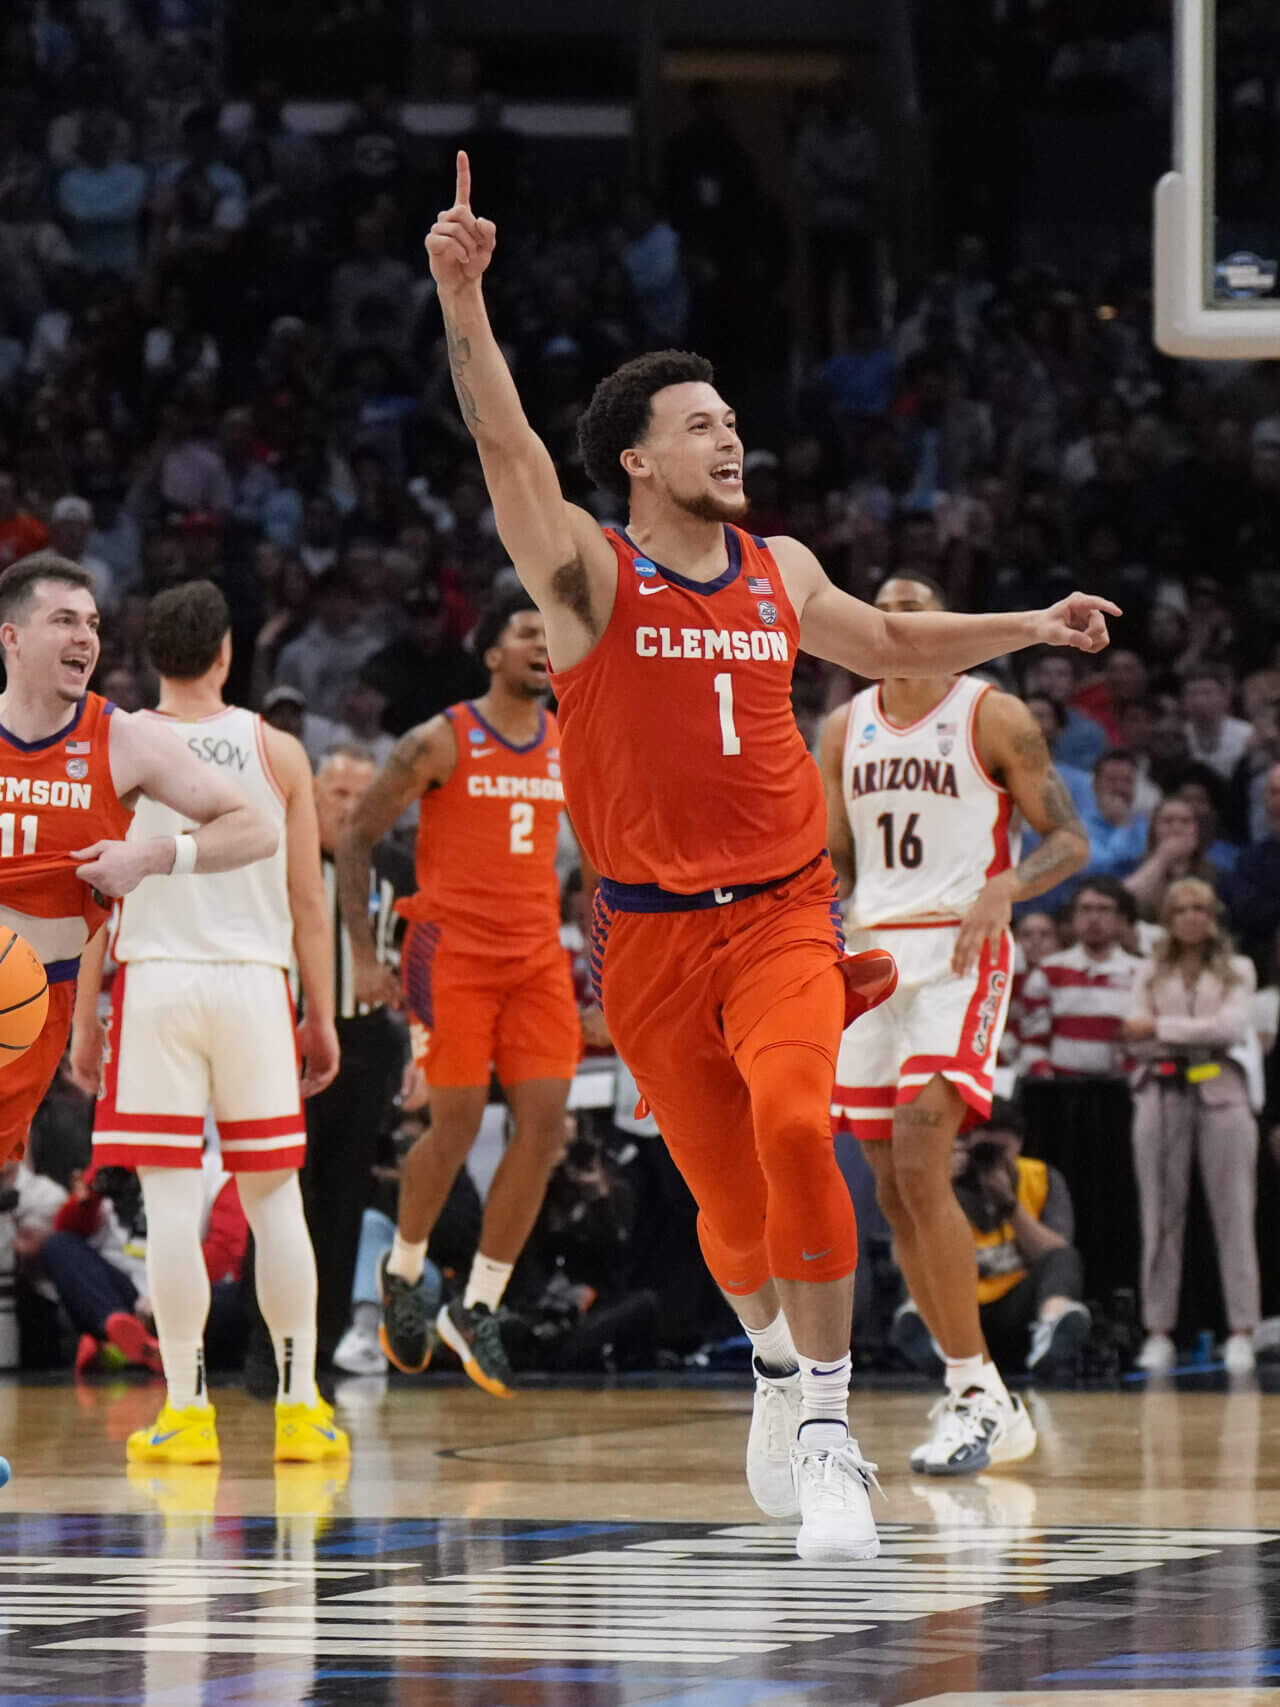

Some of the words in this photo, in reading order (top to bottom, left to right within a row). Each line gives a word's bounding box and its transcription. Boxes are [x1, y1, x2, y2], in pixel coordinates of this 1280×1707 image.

[635, 626, 789, 662] CLEMSON
[713, 672, 741, 756] 1
[0, 776, 92, 810] MSON
[852, 757, 961, 800] ARIZONA
[0, 811, 39, 858] 11
[509, 802, 535, 855] 2
[876, 812, 923, 869] 16
